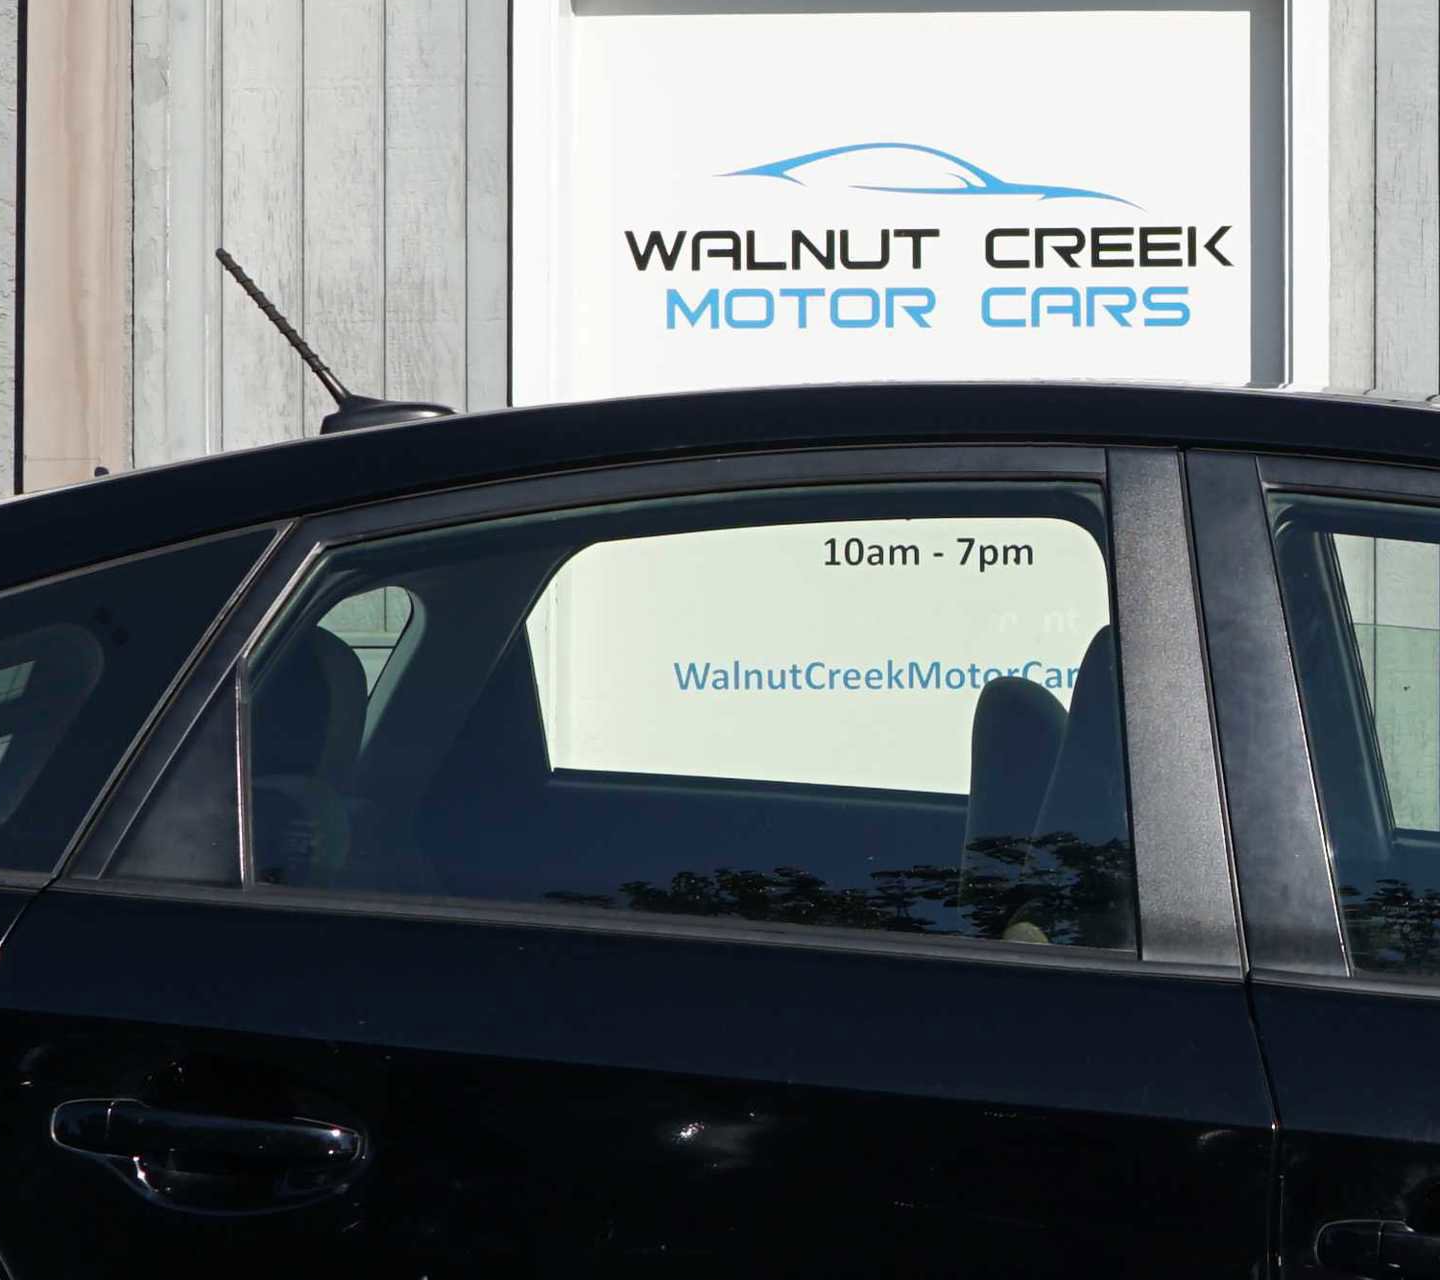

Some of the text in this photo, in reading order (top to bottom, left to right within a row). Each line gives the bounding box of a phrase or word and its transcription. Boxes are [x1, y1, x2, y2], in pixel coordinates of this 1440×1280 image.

[624, 225, 1236, 272] WALNUT CREEK
[665, 285, 1192, 331] MOTOR CARS
[824, 537, 921, 567] 10am
[957, 537, 1035, 574] 7pm
